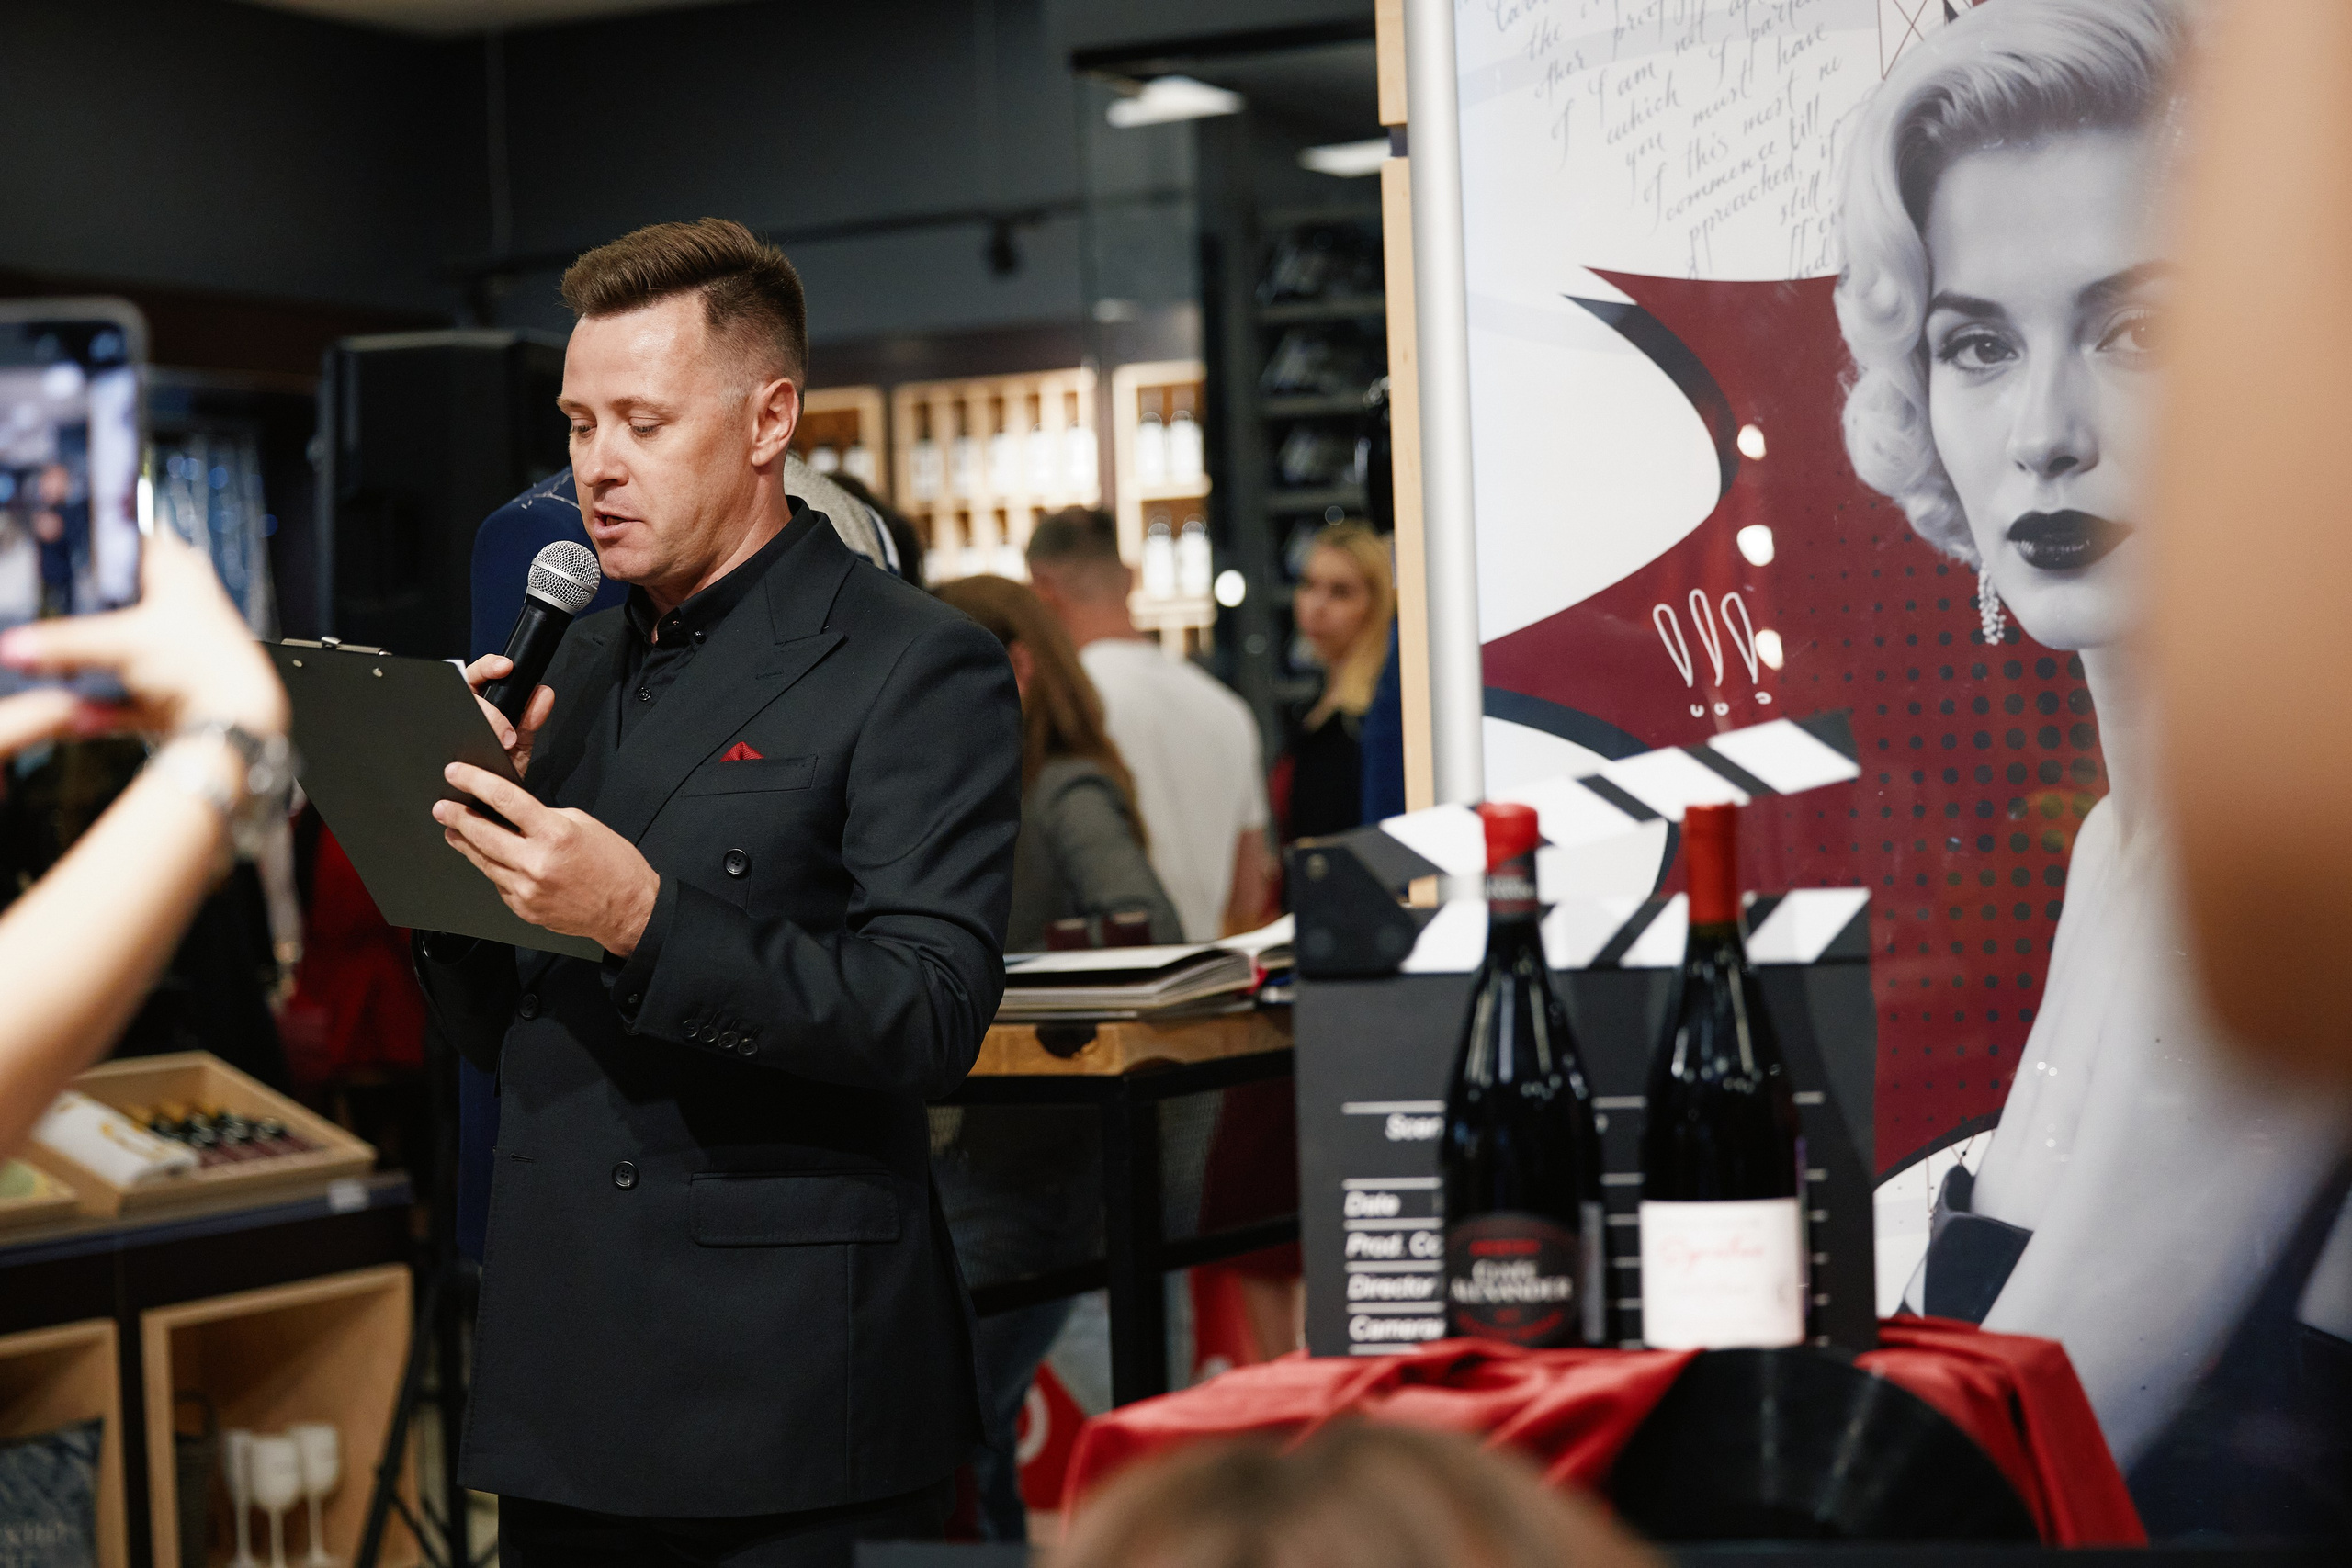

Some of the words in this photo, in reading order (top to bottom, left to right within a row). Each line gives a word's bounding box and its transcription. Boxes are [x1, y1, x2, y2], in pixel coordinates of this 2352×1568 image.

[1618, 61, 1656, 96] am
[1607, 70, 1681, 145] which
[1625, 132, 1666, 208] you
[1691, 59, 1751, 128] must
[1777, 22, 1828, 74] have
[1680, 131, 1728, 179] this
[1743, 69, 1799, 136] most
[1666, 140, 1776, 221] commence
[1789, 92, 1820, 151] till
[1344, 1190, 1401, 1217] Date
[1345, 1232, 1408, 1258] Prod.
[1347, 1273, 1437, 1301] Director
